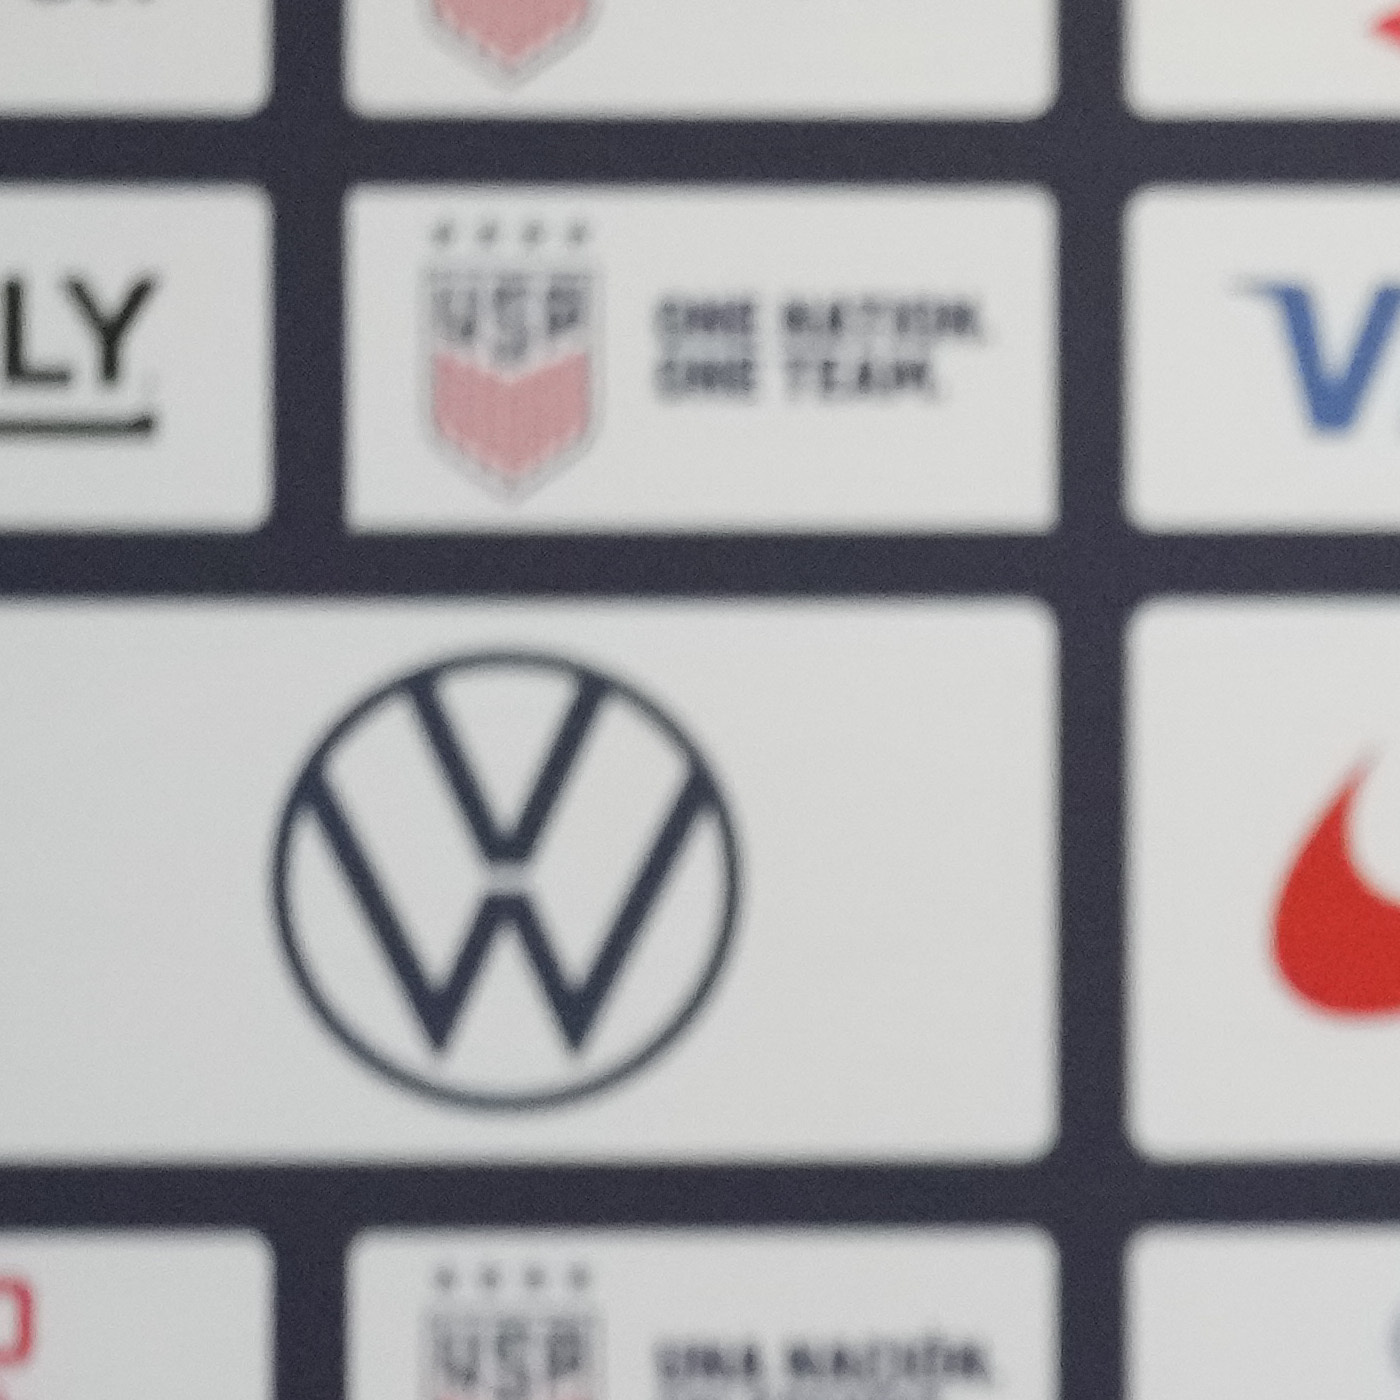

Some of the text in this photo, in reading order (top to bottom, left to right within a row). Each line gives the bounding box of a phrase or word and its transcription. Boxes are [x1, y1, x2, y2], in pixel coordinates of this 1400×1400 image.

[652, 292, 760, 343] ONE
[652, 350, 760, 402] ONE
[653, 1338, 764, 1386] UNA
